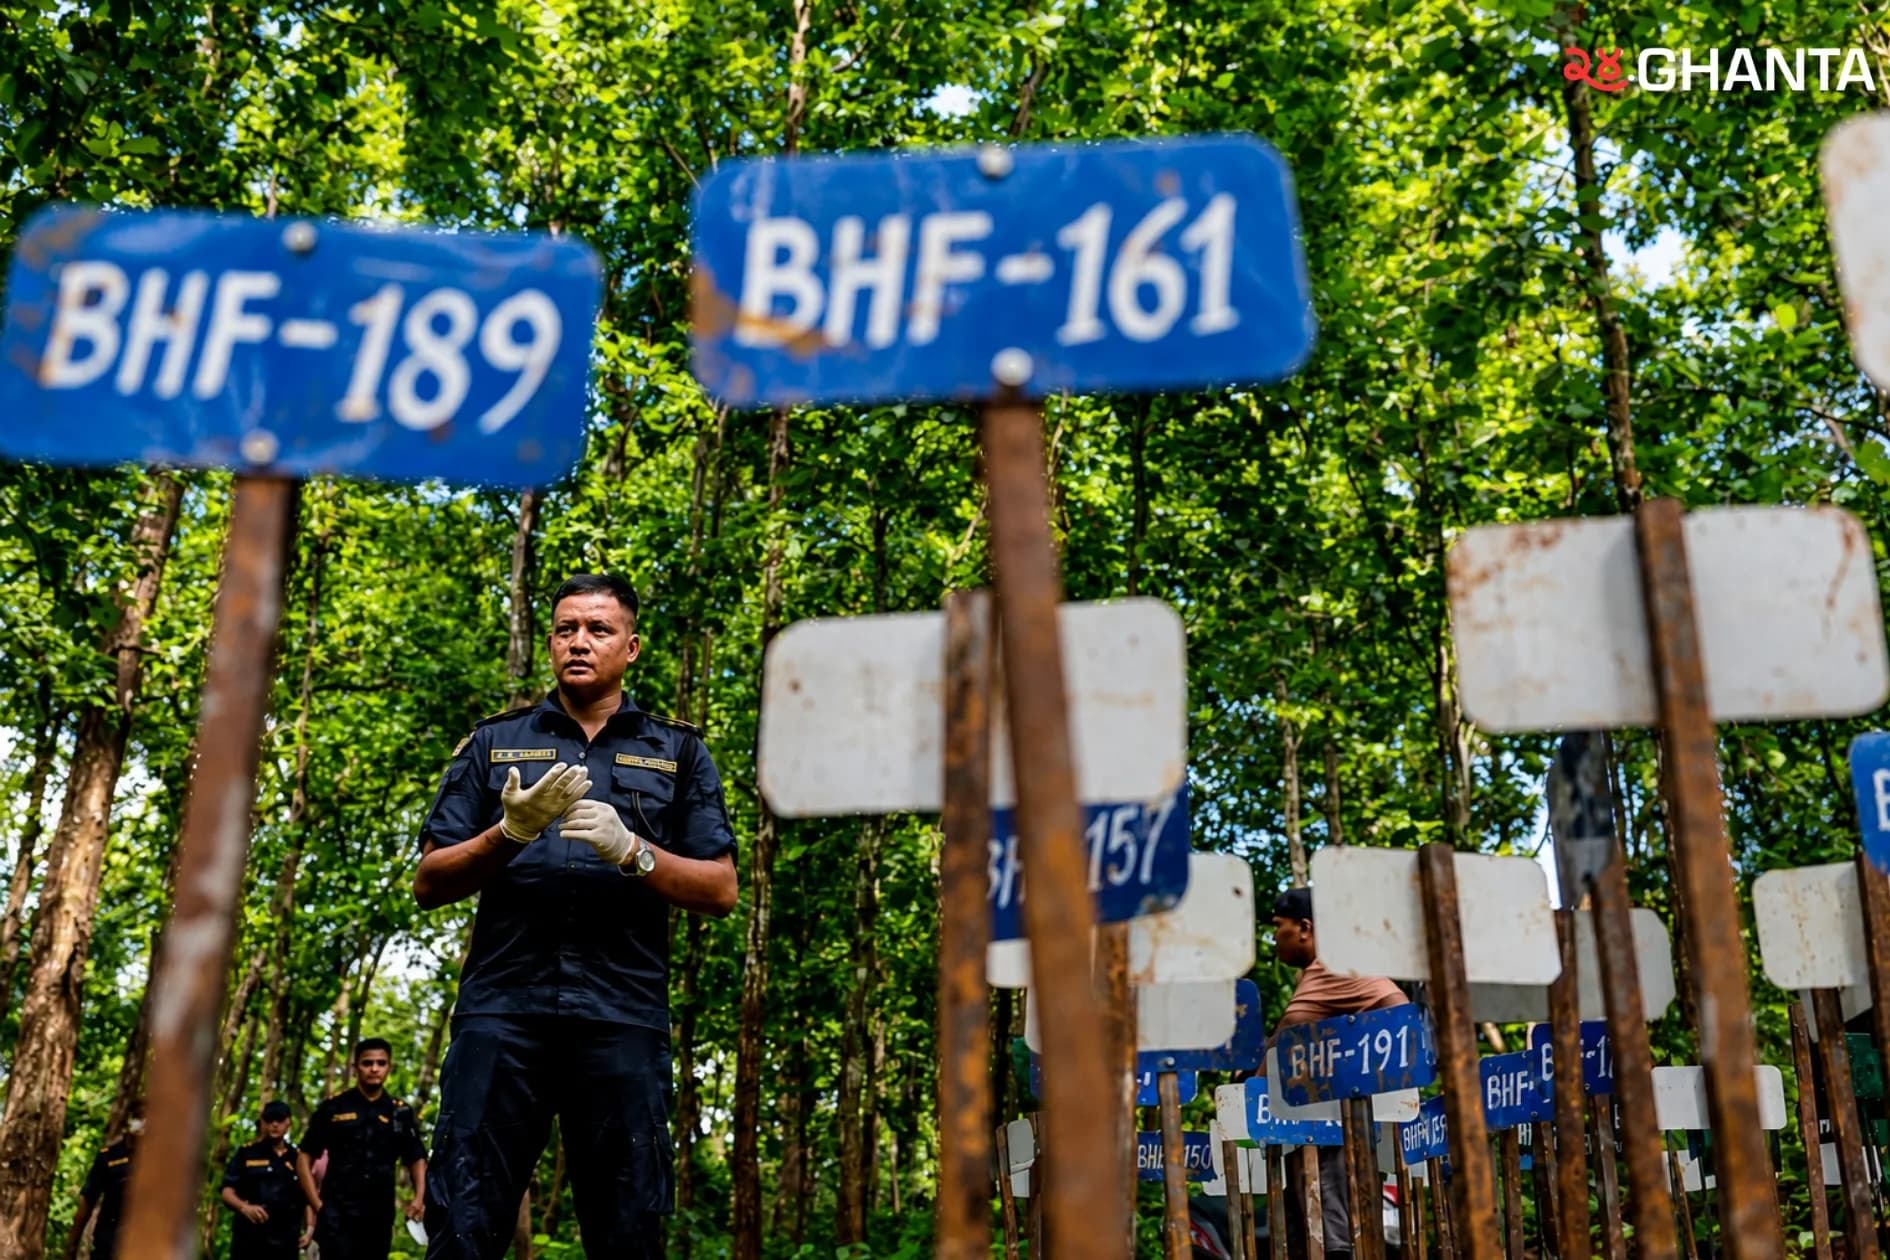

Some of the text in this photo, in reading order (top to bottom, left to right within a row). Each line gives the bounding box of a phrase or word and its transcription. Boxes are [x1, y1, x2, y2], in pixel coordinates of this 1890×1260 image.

[40, 260, 563, 434] BHF-189
[733, 192, 1240, 350] BHF-161
[1291, 1025, 1408, 1079] BHF-191
